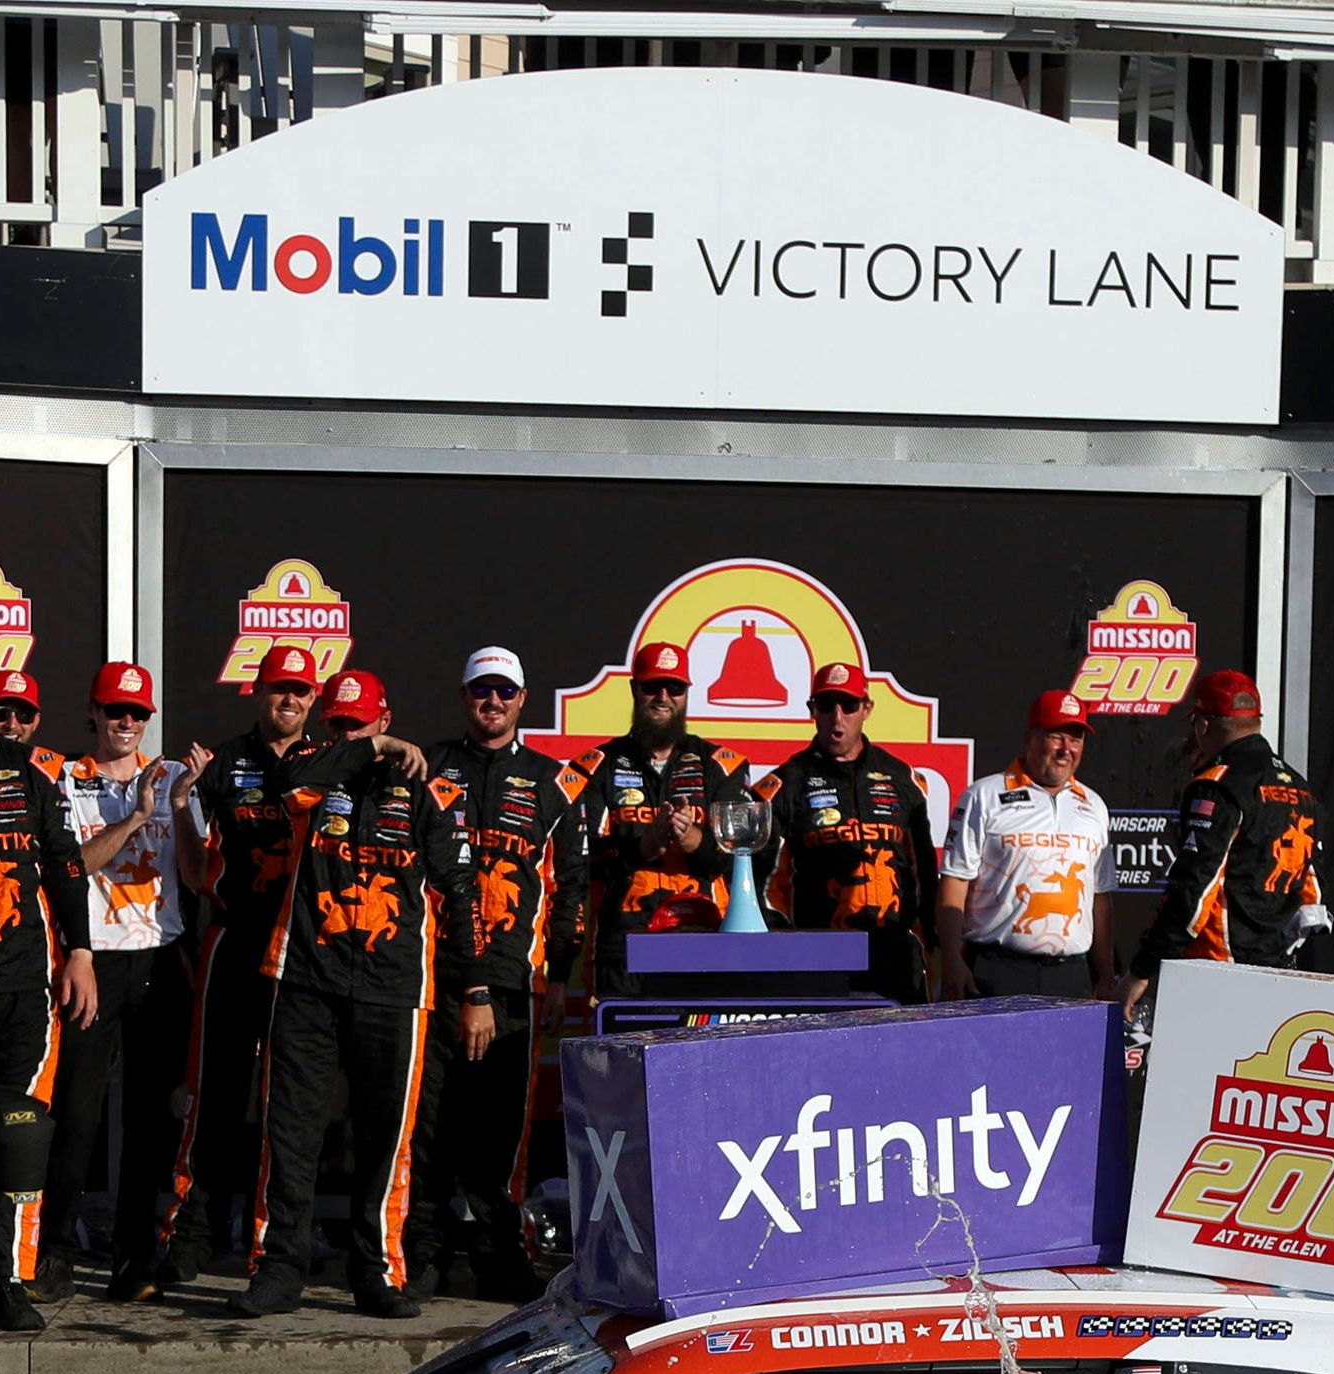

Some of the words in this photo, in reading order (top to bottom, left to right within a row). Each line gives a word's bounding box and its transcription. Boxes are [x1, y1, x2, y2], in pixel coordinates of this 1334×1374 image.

[190, 213, 443, 297] Mobil
[696, 237, 1021, 305] VICTORY
[1048, 249, 1239, 312] LANE
[245, 607, 344, 629] MISSION
[1093, 628, 1191, 649] MISSION
[218, 636, 354, 683] 20
[1070, 657, 1199, 702] 200
[1097, 703, 1110, 714] AT
[1111, 703, 1133, 714] THE
[1134, 704, 1160, 714] GLEN
[1109, 817, 1167, 832] NASCAR
[1001, 832, 1101, 857] REGISTIX
[717, 1085, 1072, 1234] xfinity
[1212, 1228, 1242, 1247] AT
[1244, 1231, 1274, 1252] THE
[1276, 1236, 1327, 1259] GLEN
[771, 1322, 906, 1349] CONNOR
